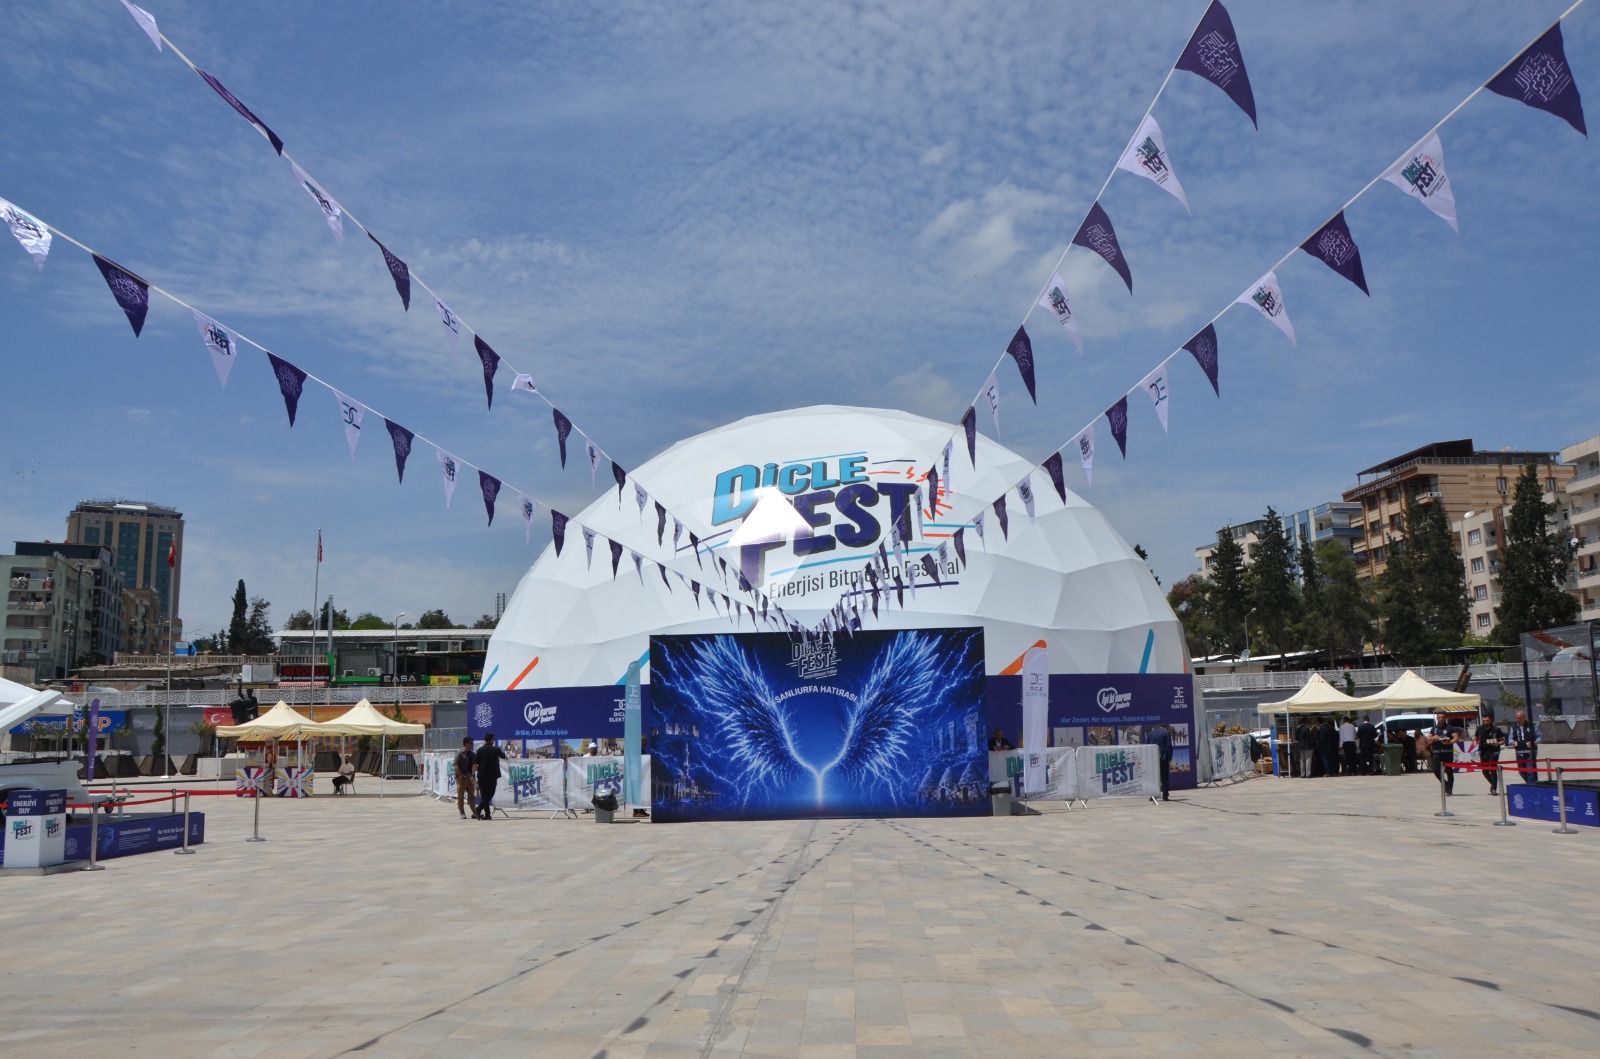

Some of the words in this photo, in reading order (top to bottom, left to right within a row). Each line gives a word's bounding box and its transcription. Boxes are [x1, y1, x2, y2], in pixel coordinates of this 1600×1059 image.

[739, 482, 919, 591] FEST
[769, 572, 824, 600] Enerjisi
[904, 557, 959, 578] Fesial
[798, 651, 831, 678] FEST
[383, 675, 417, 683] CASA
[514, 776, 542, 804] FEST
[1102, 762, 1136, 793] FEST
[15, 825, 32, 839] FEST
